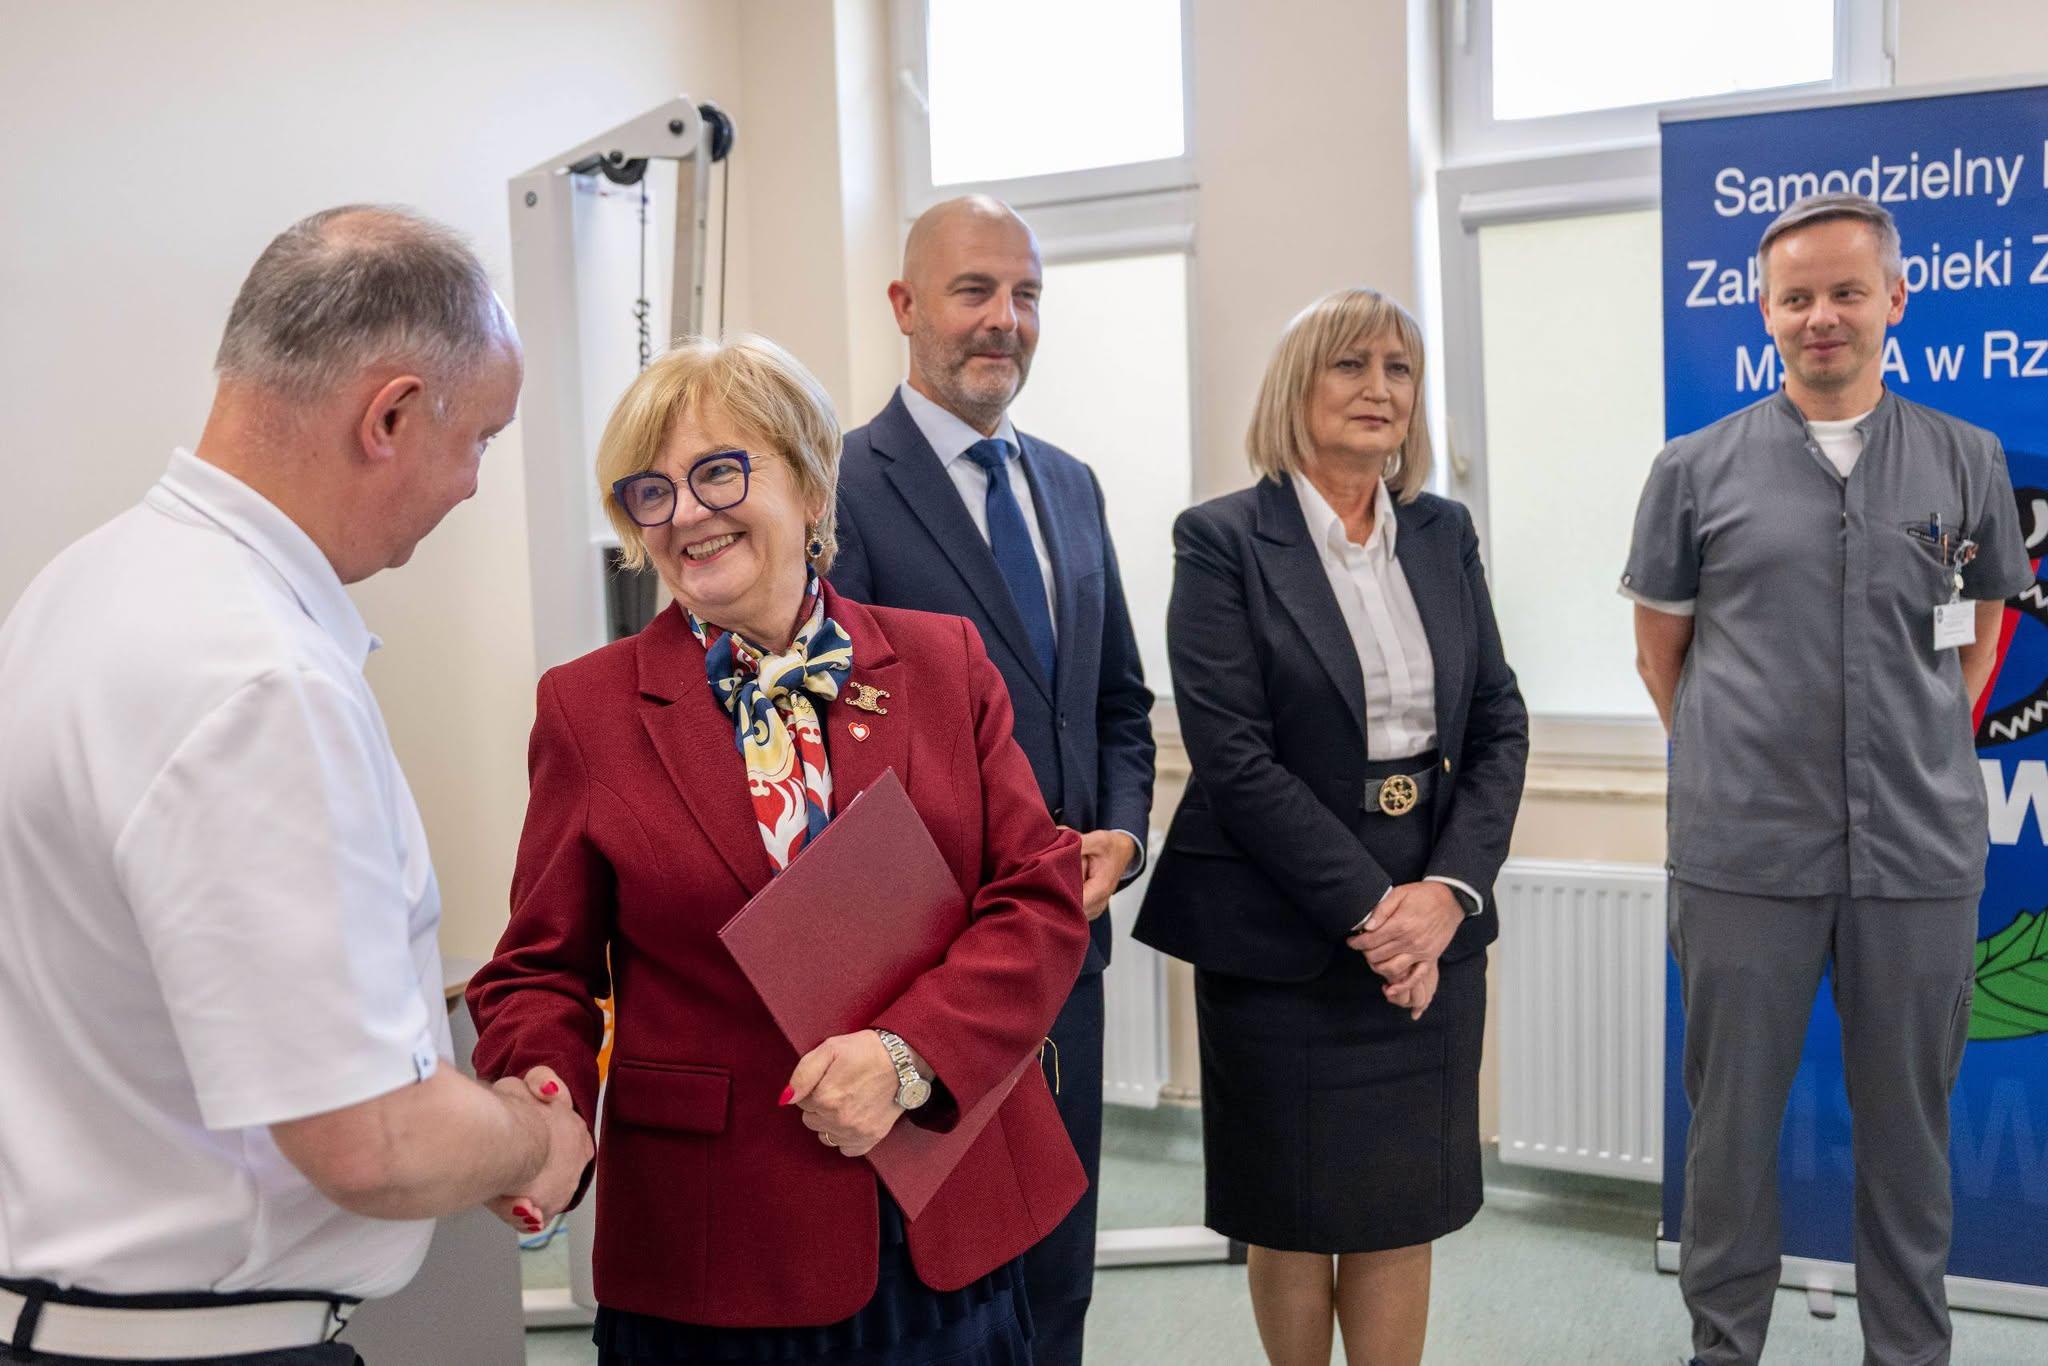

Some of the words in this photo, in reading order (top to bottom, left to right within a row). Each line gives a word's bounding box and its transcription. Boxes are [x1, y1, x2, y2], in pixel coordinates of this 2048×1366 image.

[1713, 147, 2024, 217] Samodzielny
[1684, 255, 1762, 308] Zak
[1900, 237, 2012, 304] pieki
[1925, 345, 1965, 383] w
